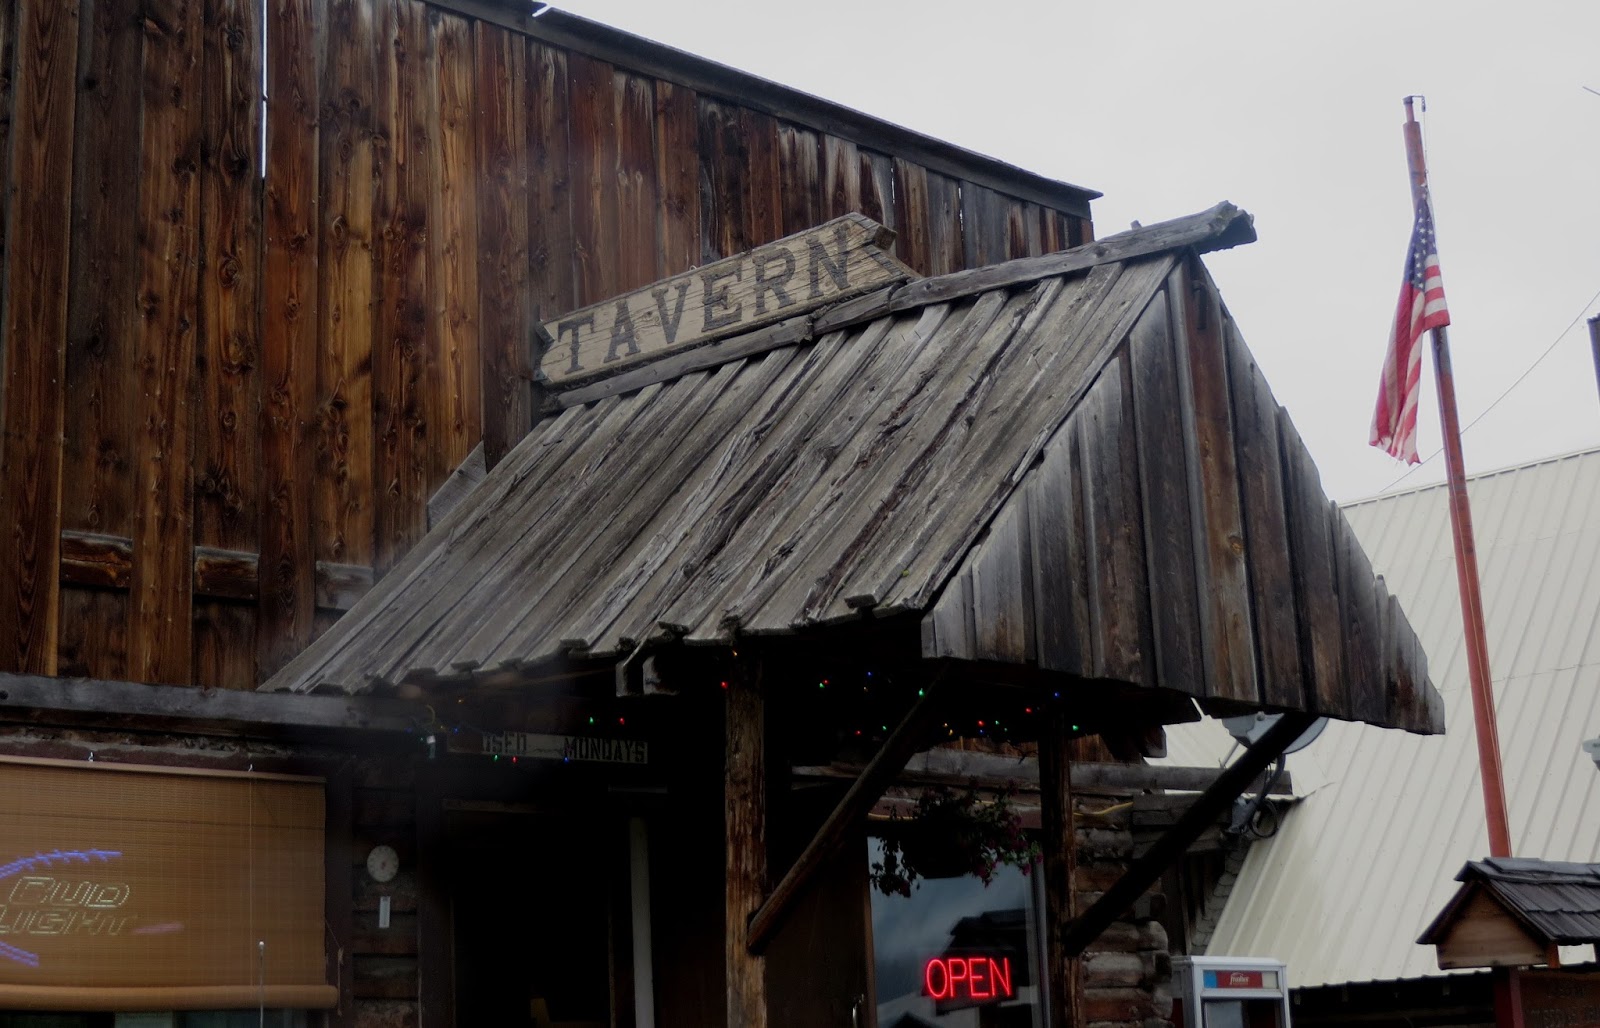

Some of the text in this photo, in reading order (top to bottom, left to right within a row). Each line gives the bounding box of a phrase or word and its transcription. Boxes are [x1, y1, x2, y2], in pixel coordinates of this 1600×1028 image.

[557, 222, 851, 375] TAVERN
[563, 736, 645, 763] MONDAYS
[925, 957, 1012, 999] OPEN
